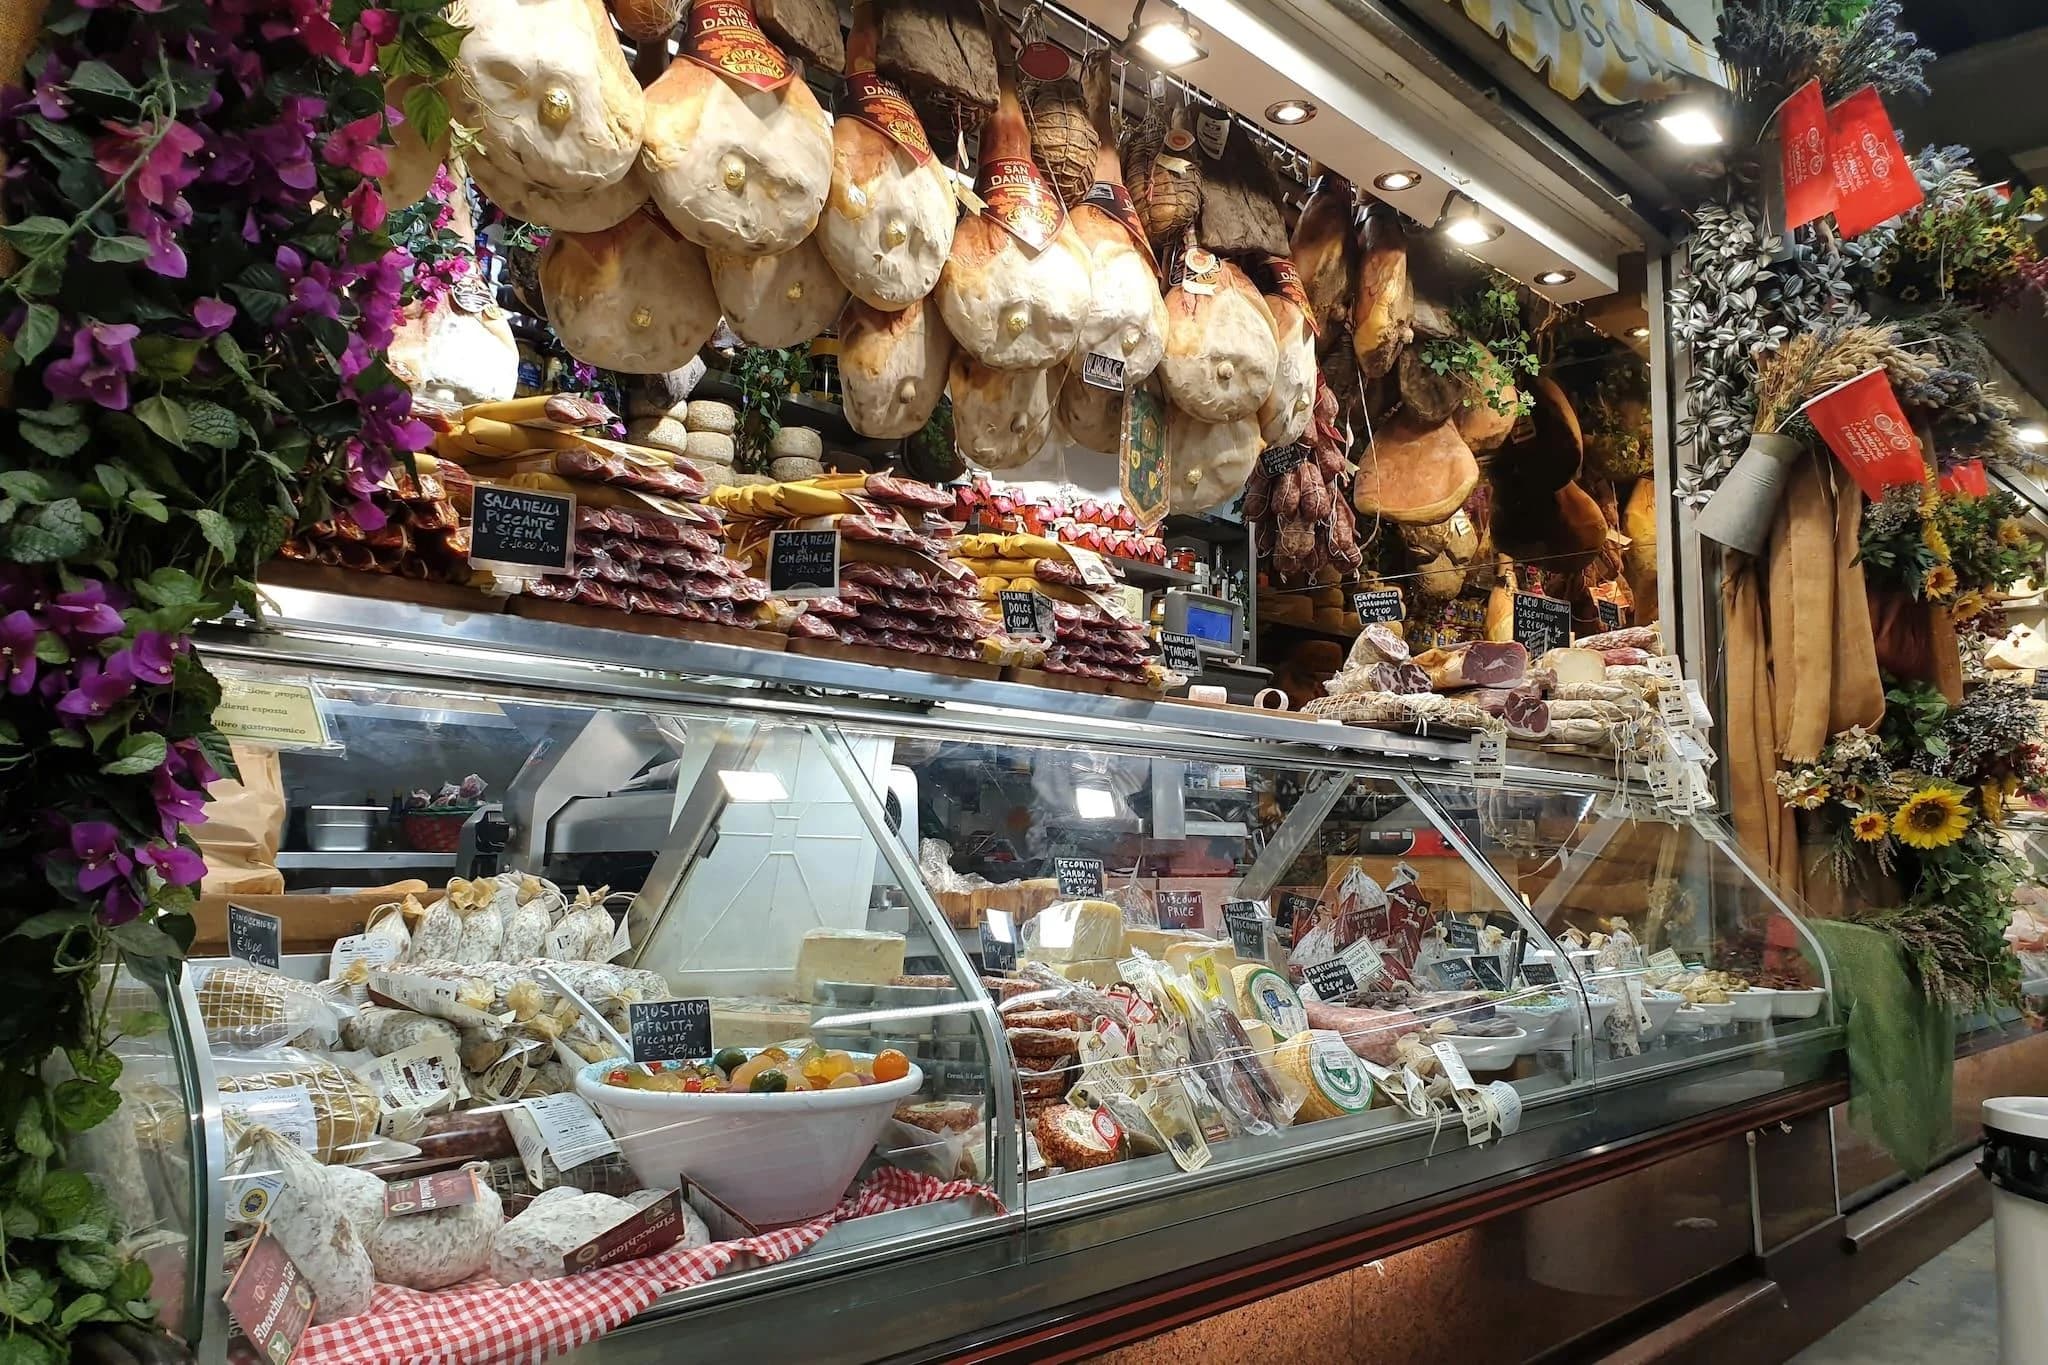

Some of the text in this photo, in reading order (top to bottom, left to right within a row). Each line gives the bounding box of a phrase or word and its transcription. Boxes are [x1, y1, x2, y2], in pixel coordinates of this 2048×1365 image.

[718, 8, 748, 20] SAN
[1003, 165, 1029, 176] SAN
[991, 174, 1042, 187] DANIELE
[778, 550, 833, 563] CINGHIALE
[1009, 602, 1032, 614] DOLCE
[214, 719, 306, 735] libro gastronomico
[1058, 860, 1099, 869] PECORINO
[1060, 869, 1085, 878] SARDO
[1063, 877, 1097, 885] TARTUFO
[1167, 905, 1195, 918] PRICE
[1235, 930, 1258, 945] PRICE
[636, 1002, 708, 1018] MUSTARDA
[647, 1019, 694, 1033] FRUTTA
[636, 1032, 687, 1045] PICCANTE
[600, 1212, 676, 1262] Finocchiona
[253, 1280, 291, 1345] Finocchiona
